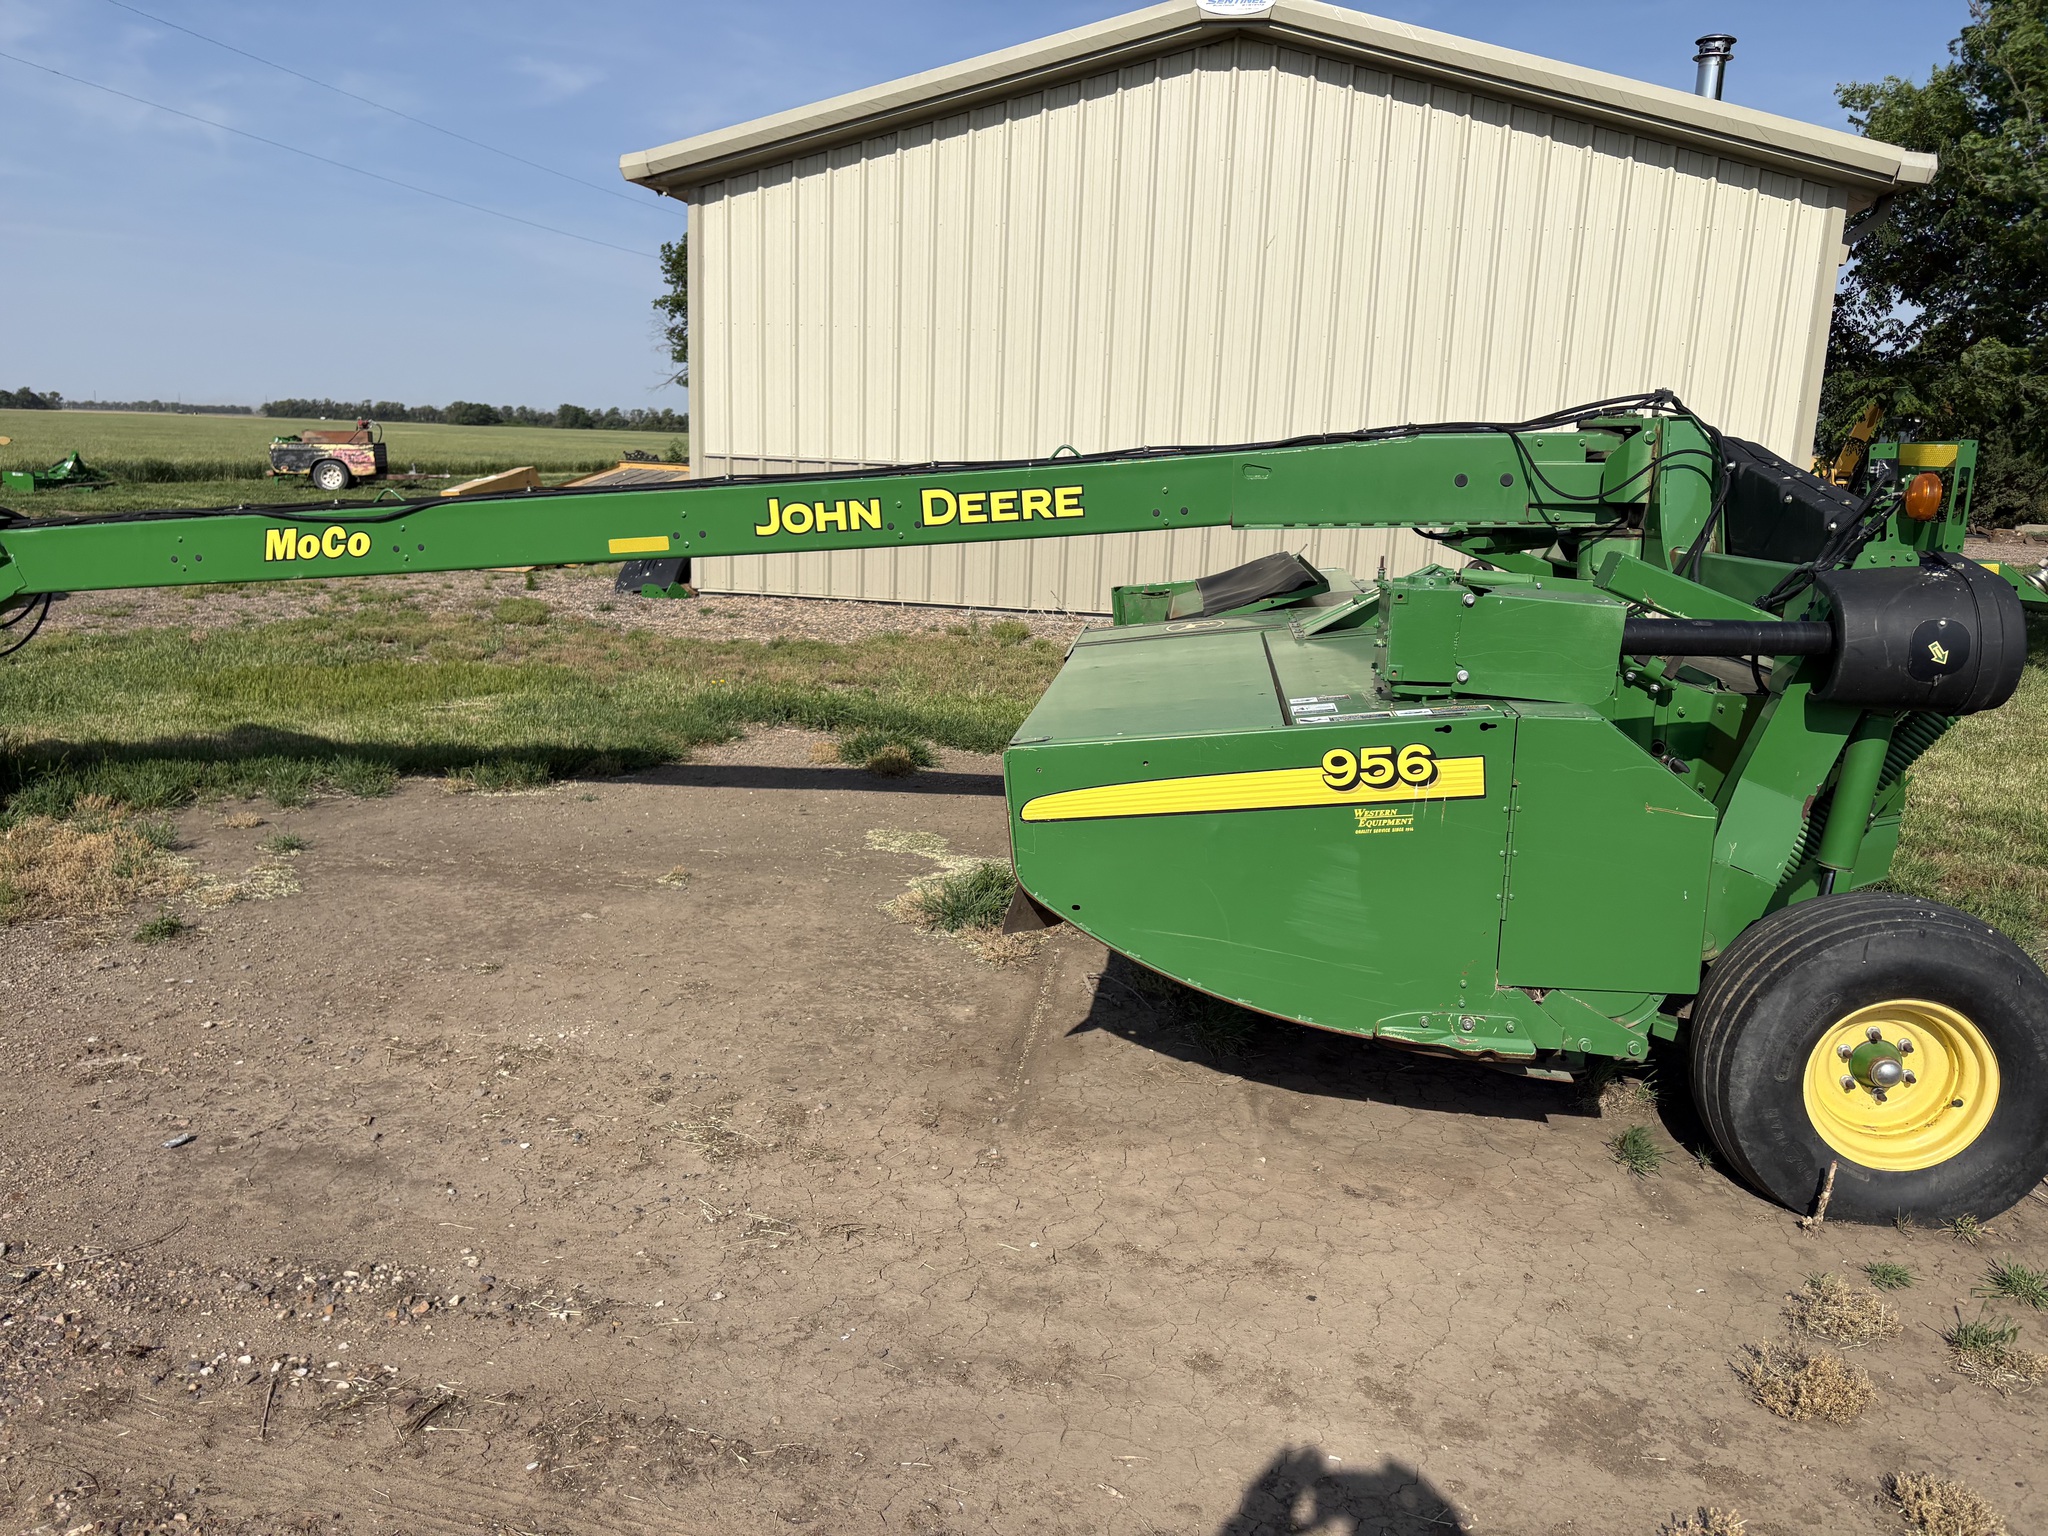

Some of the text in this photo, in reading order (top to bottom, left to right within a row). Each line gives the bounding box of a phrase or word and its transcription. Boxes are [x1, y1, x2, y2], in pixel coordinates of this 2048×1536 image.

[754, 485, 1085, 537] JOHN DEERE
[264, 525, 371, 562] MoCo
[1321, 743, 1437, 791] 956
[1354, 808, 1398, 818] WESTERN
[1358, 817, 1414, 828] EQUIPMENT
